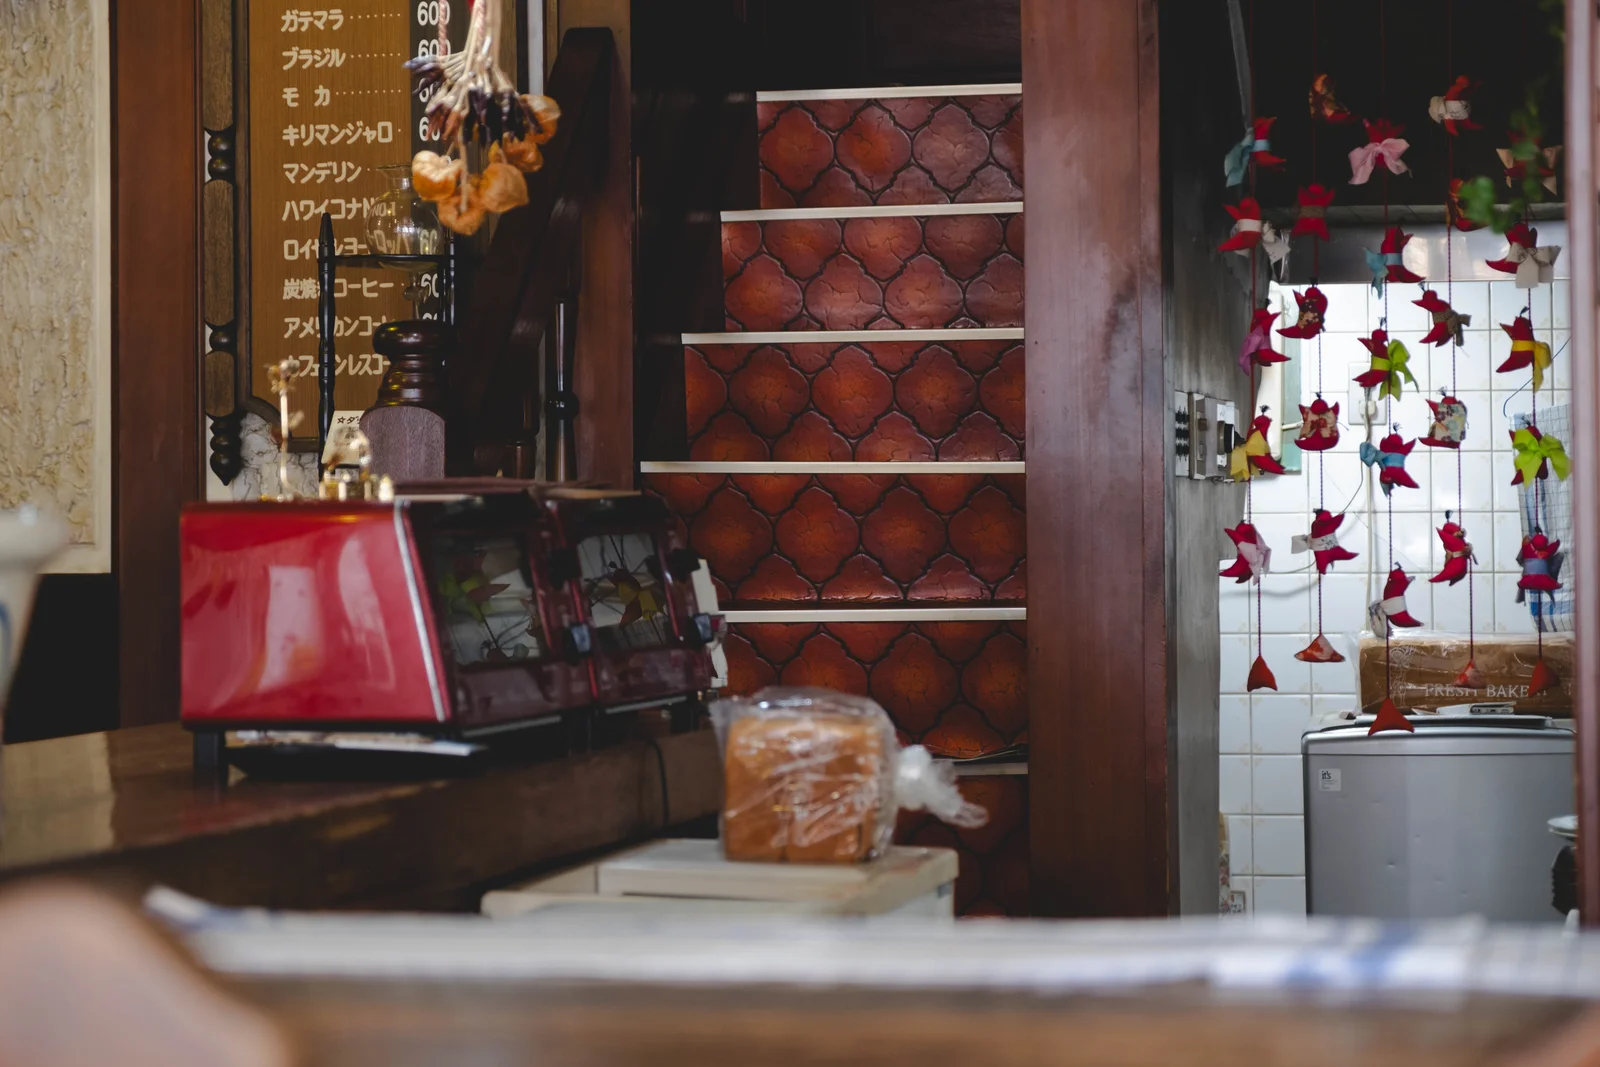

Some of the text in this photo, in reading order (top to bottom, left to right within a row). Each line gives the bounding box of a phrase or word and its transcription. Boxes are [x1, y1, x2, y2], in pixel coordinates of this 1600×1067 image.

[281, 9, 344, 32] ガテマラ
[282, 47, 346, 70] ブラジル
[282, 121, 393, 146] キリマンジャロ
[283, 161, 361, 184] マンデリン
[283, 278, 394, 300] 炭焼コーヒー
[1425, 683, 1547, 698] FRESH BAKE
